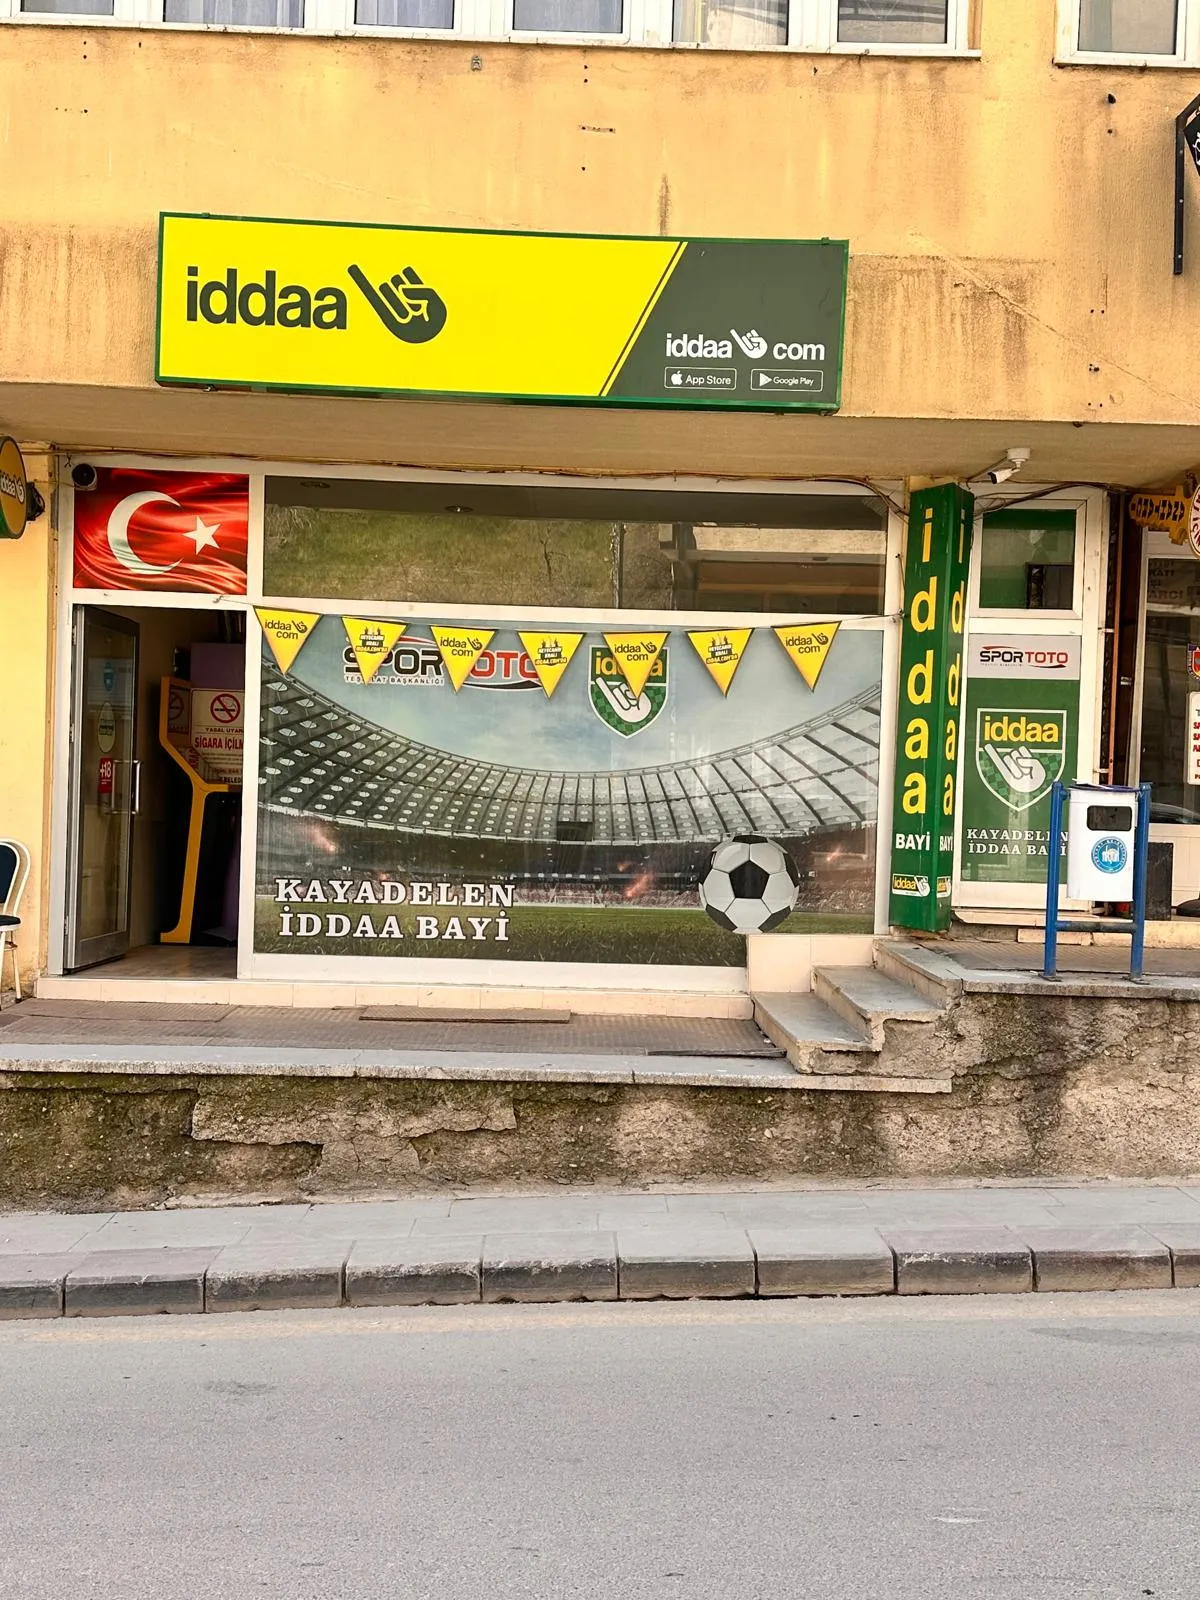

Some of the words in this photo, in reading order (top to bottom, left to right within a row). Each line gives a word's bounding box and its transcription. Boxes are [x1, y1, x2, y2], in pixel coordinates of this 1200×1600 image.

[186, 265, 347, 330] iddaa
[666, 333, 733, 358] iddaa
[773, 342, 825, 360] com
[685, 374, 704, 386] App
[706, 375, 732, 385] Store
[773, 376, 799, 386] Google
[799, 377, 815, 387] Play
[264, 618, 292, 631] iddaa
[276, 630, 299, 640] com
[439, 635, 467, 649] iddaa
[785, 634, 813, 647] iddaa
[451, 647, 474, 658] com
[614, 643, 642, 654] iddaa
[797, 644, 821, 655] com
[595, 650, 663, 677] ida
[626, 652, 649, 662] com
[345, 675, 388, 684] TEŞLAT
[983, 715, 1059, 743] iddaa
[194, 735, 223, 749] SİGARA
[895, 831, 931, 851] BAYİ
[968, 839, 1022, 855] İDDAA
[1026, 842, 1068, 857] BAİ
[894, 876, 917, 890] iddaa
[275, 878, 516, 908] KAYADELEN
[278, 905, 404, 938] İDDAA
[416, 910, 510, 941] BAYİ
